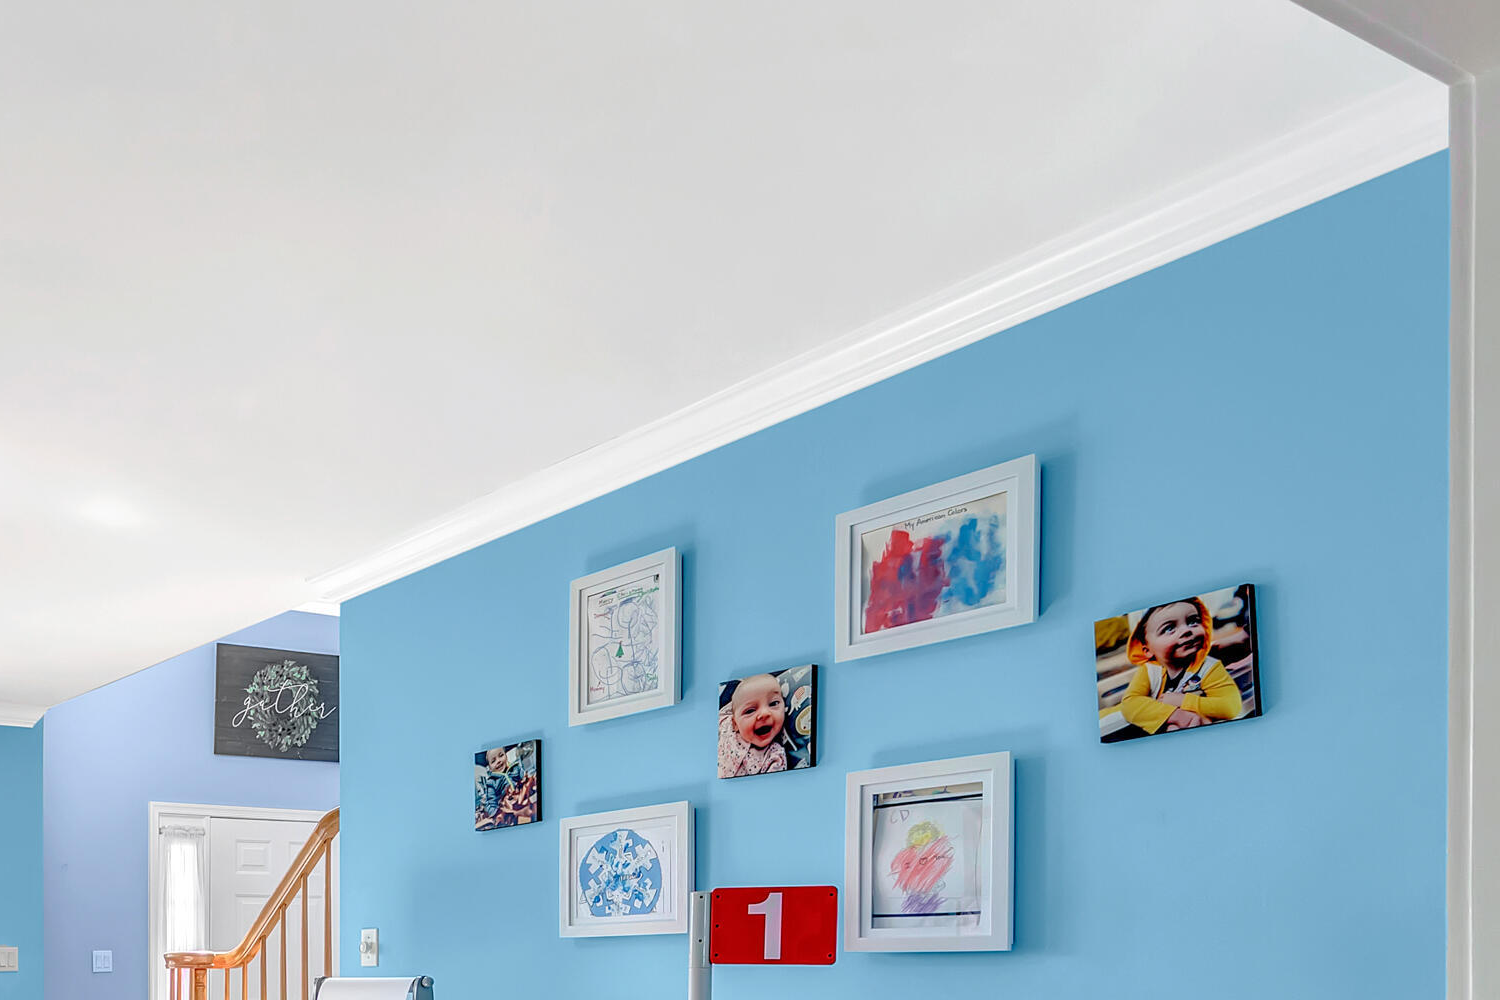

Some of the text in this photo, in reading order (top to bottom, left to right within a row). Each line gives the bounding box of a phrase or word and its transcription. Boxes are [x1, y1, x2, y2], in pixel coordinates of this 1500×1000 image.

[904, 507, 968, 531] My American Colors
[232, 679, 336, 728] gather
[747, 892, 783, 960] 1
